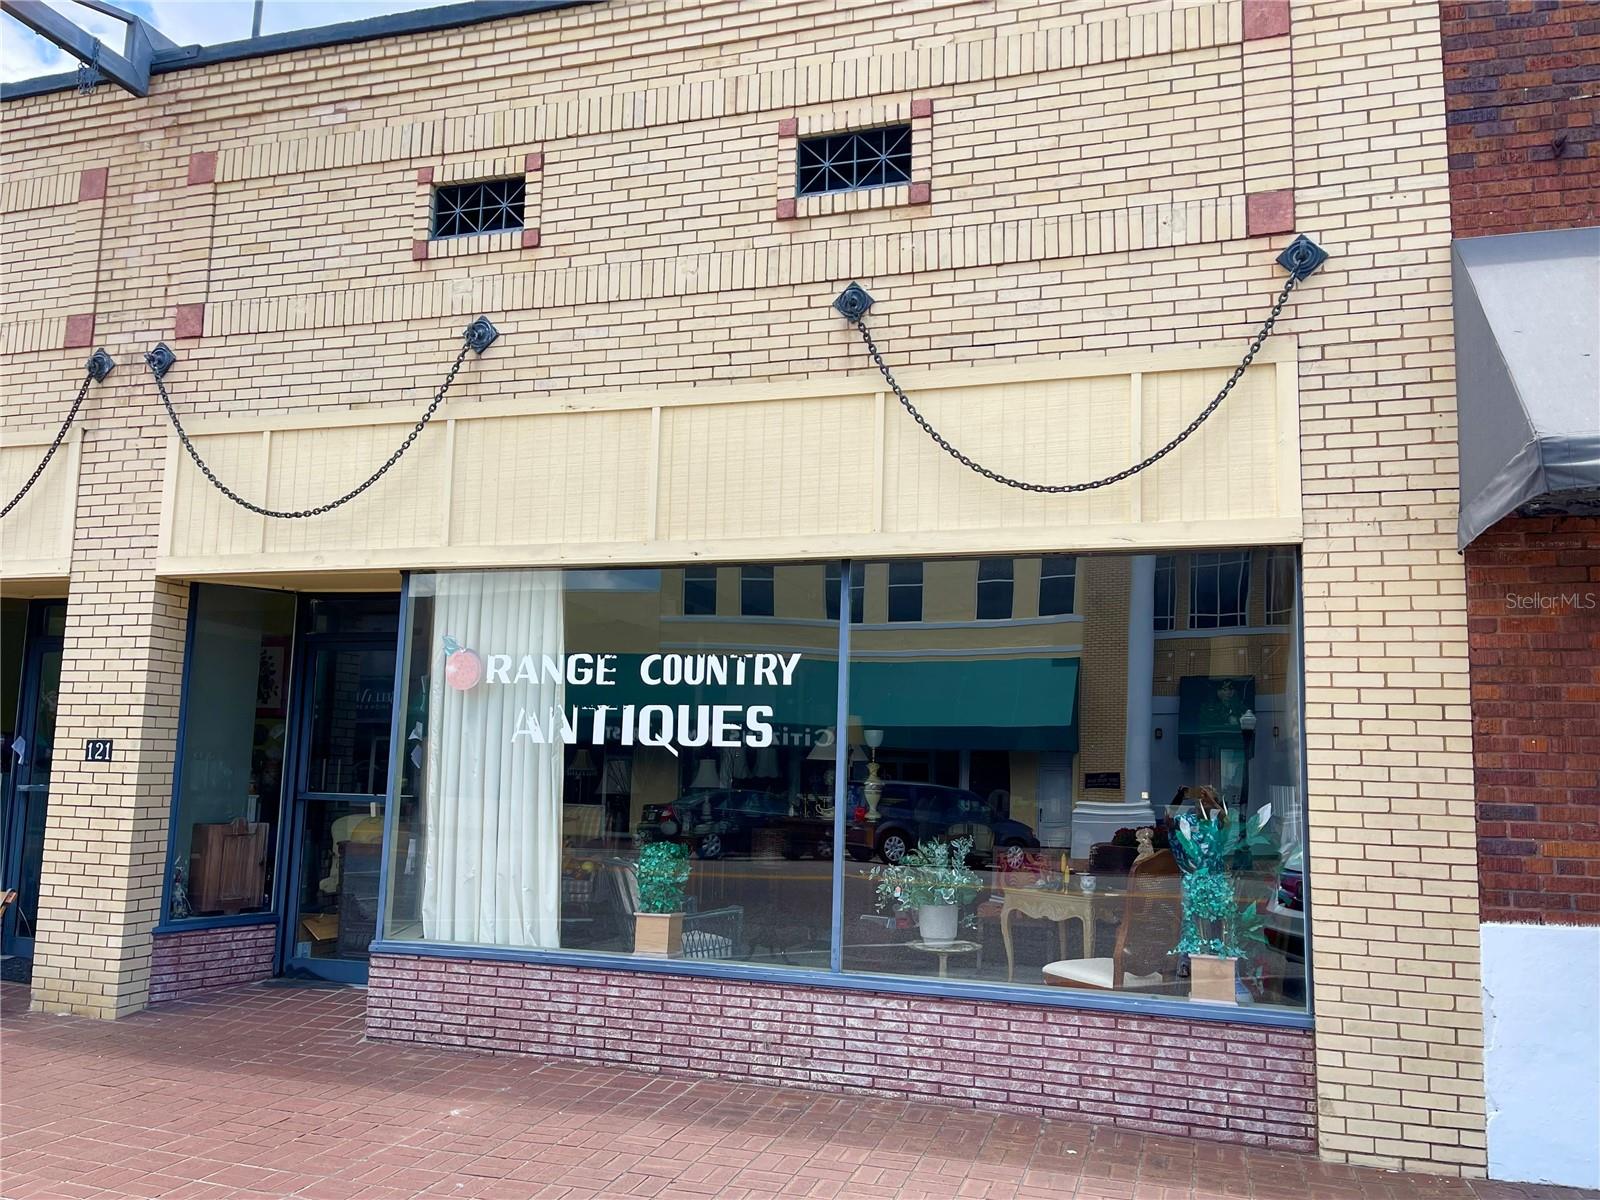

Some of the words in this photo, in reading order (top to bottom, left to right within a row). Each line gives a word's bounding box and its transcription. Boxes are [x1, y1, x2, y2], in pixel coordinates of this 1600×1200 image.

[640, 653, 801, 686] COUNTRY
[511, 704, 774, 757] ANTIQUES
[87, 742, 111, 760] 121
